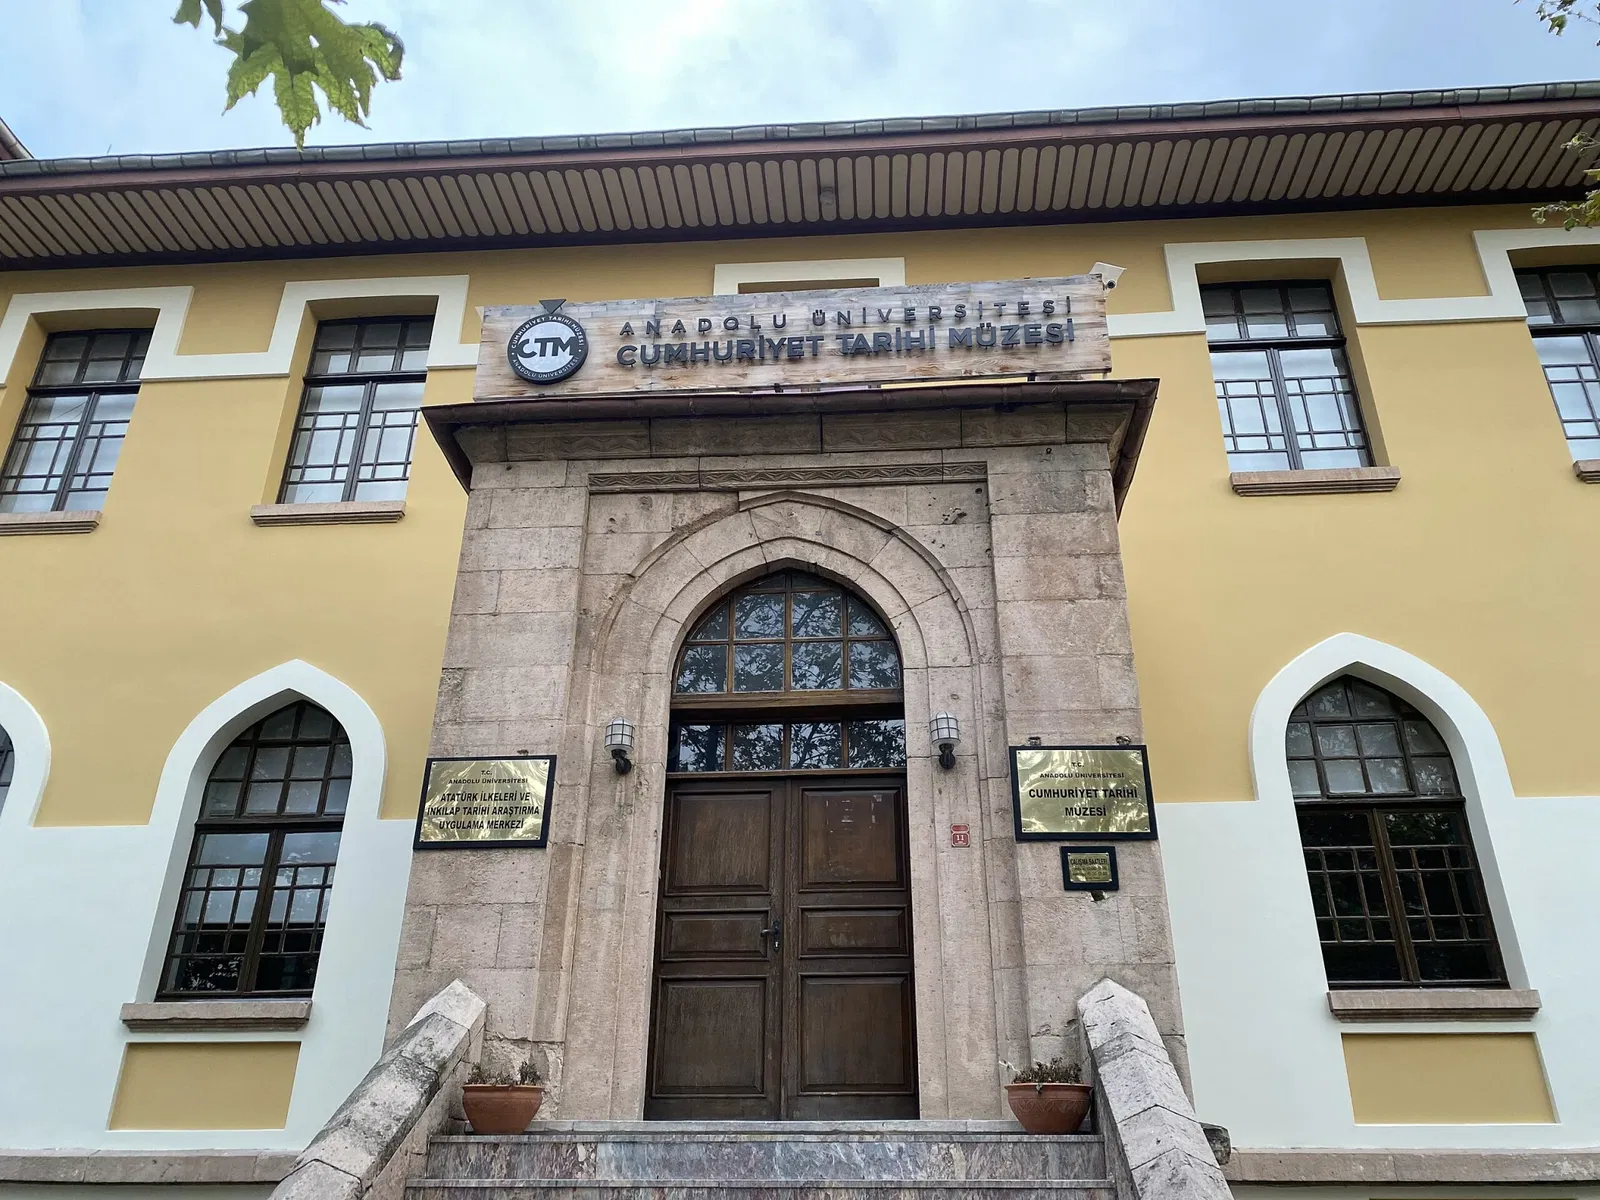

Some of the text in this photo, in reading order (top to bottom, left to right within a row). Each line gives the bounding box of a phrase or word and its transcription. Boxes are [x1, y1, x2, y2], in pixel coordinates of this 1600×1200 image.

[619, 296, 1072, 335] ANADOLU ÜNİVERSİTESİ
[511, 315, 585, 349] CUMHURİYET TARİHİ MÜZESİ
[517, 336, 577, 358] CTM
[616, 318, 1075, 366] CUMHURİYET TARİHİ MÜZESİ
[512, 359, 537, 378] ANADOLU
[440, 790, 530, 801] ATATÜRK İLKELERİ VE
[1028, 787, 1138, 798] CUMHURİYET TARİHİ
[463, 805, 490, 815] TARİHİ
[492, 805, 540, 817] ARAŞTIRMA
[439, 818, 525, 829] UYGULAMA MERKEZİ
